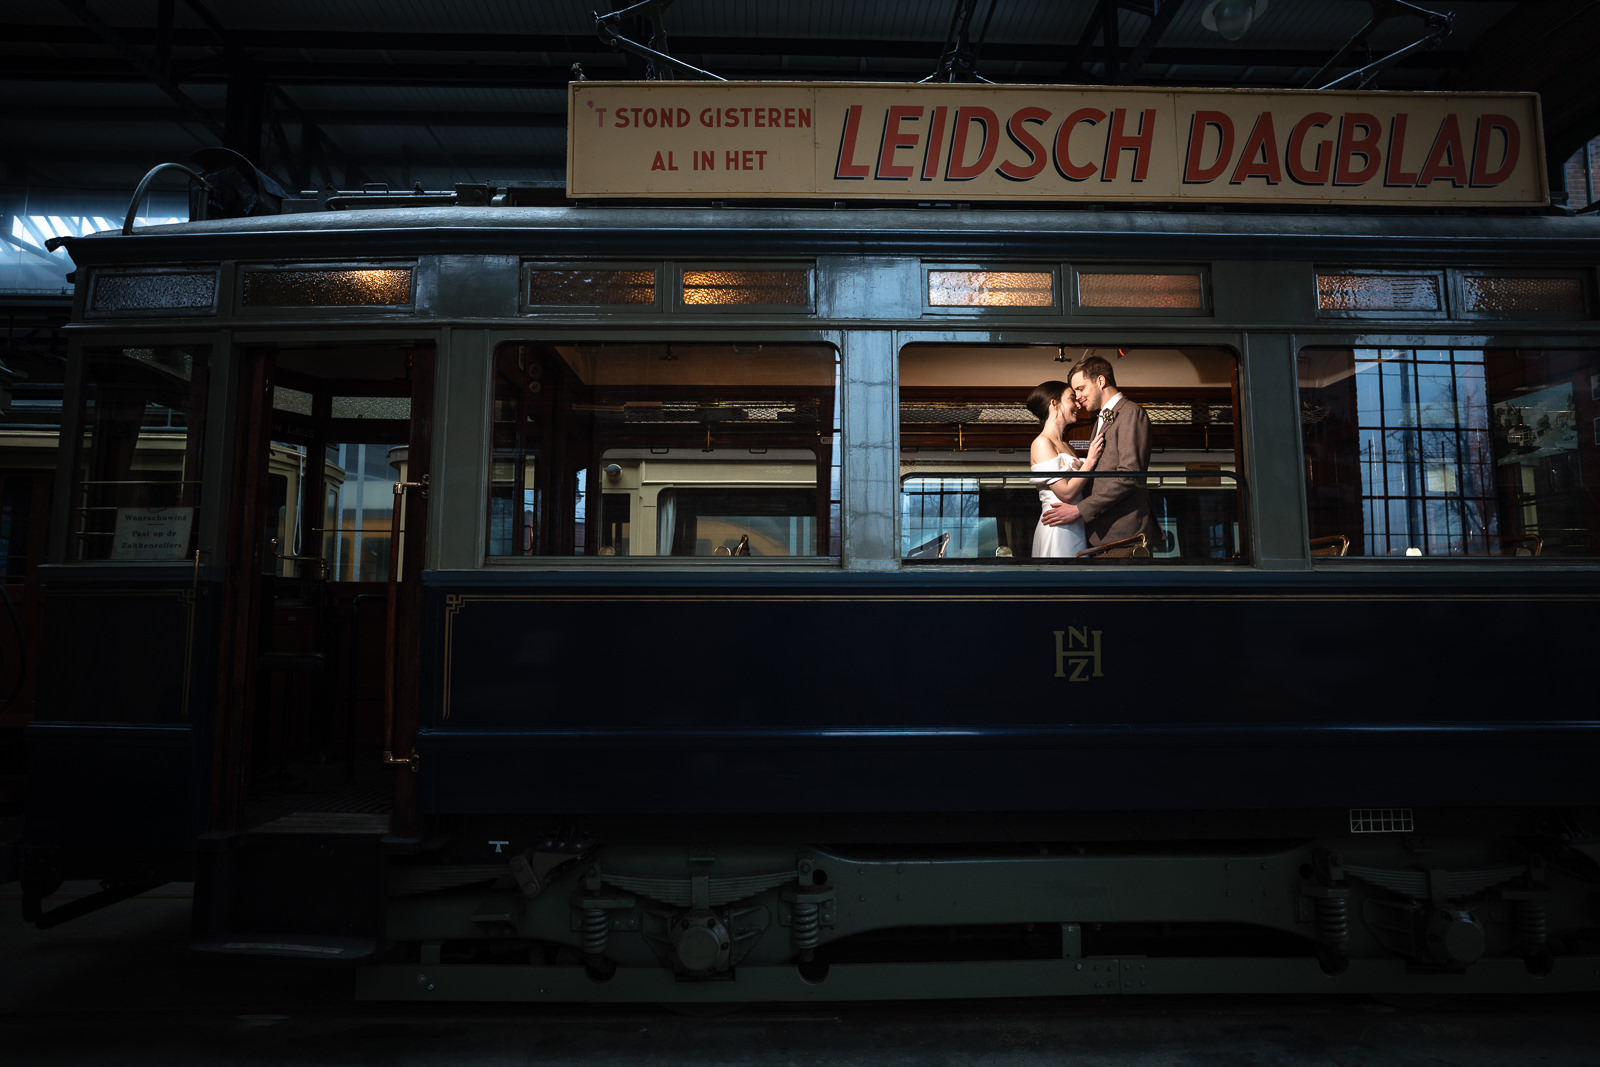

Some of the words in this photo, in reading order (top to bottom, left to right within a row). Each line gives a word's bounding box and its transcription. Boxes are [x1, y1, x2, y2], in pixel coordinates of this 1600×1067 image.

[614, 107, 691, 128] STOND
[700, 107, 811, 128] GISTEREN
[834, 104, 1157, 182] LEIDSCH
[1182, 110, 1521, 188] DAGBLAD
[651, 150, 679, 171] AL
[693, 150, 715, 171] IN
[725, 150, 767, 171] HET
[121, 541, 182, 549] Zakkenrollers
